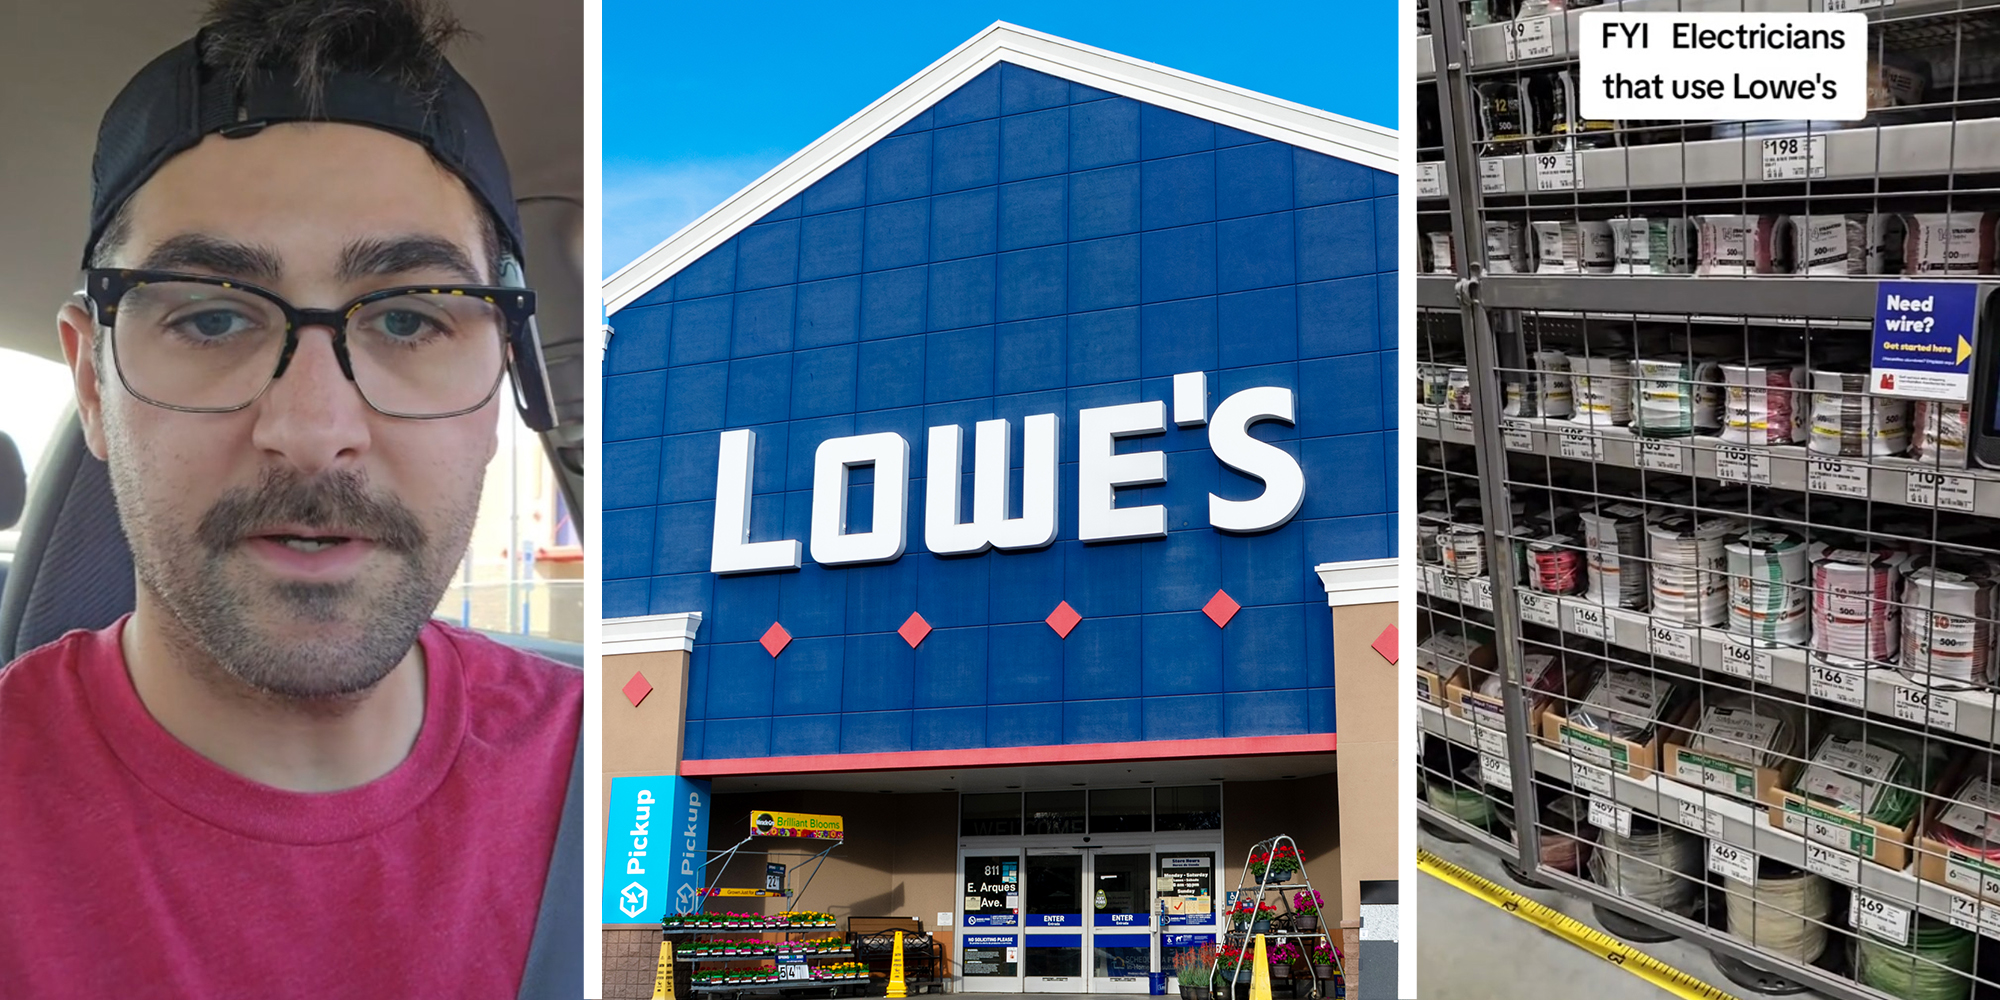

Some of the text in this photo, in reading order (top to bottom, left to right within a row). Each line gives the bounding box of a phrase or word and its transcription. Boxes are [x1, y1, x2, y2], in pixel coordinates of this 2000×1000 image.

[1495, 98, 1507, 112] 12
[1499, 122, 1512, 130] 500
[1764, 139, 1798, 155] $198
[1538, 156, 1556, 169] $99
[1814, 247, 1828, 256] 500
[1887, 295, 1934, 312] Need
[1886, 315, 1934, 333] wire?
[1884, 342, 1952, 354] Get started here
[1886, 415, 1899, 424] 500
[710, 371, 1305, 575] LOWE'S
[1576, 607, 1598, 622] $166
[1840, 608, 1854, 616] 500
[1934, 615, 1950, 629] 10
[1940, 638, 1956, 646] 500
[1724, 644, 1750, 661] $166
[1812, 667, 1842, 684] $166
[1897, 687, 1928, 706] $166
[1705, 772, 1715, 782] 50
[776, 816, 808, 828] Brilliant
[810, 818, 840, 830] Blooms
[1786, 816, 1827, 836] 6 50
[626, 790, 656, 874] Pickup
[681, 792, 702, 876] Pickup
[1712, 843, 1738, 862] $469
[984, 865, 1000, 876] 811
[968, 882, 1016, 894] E. Arques
[1950, 870, 1999, 894] 6 50
[980, 898, 1002, 908] Ave.
[1855, 894, 1884, 914] $469
